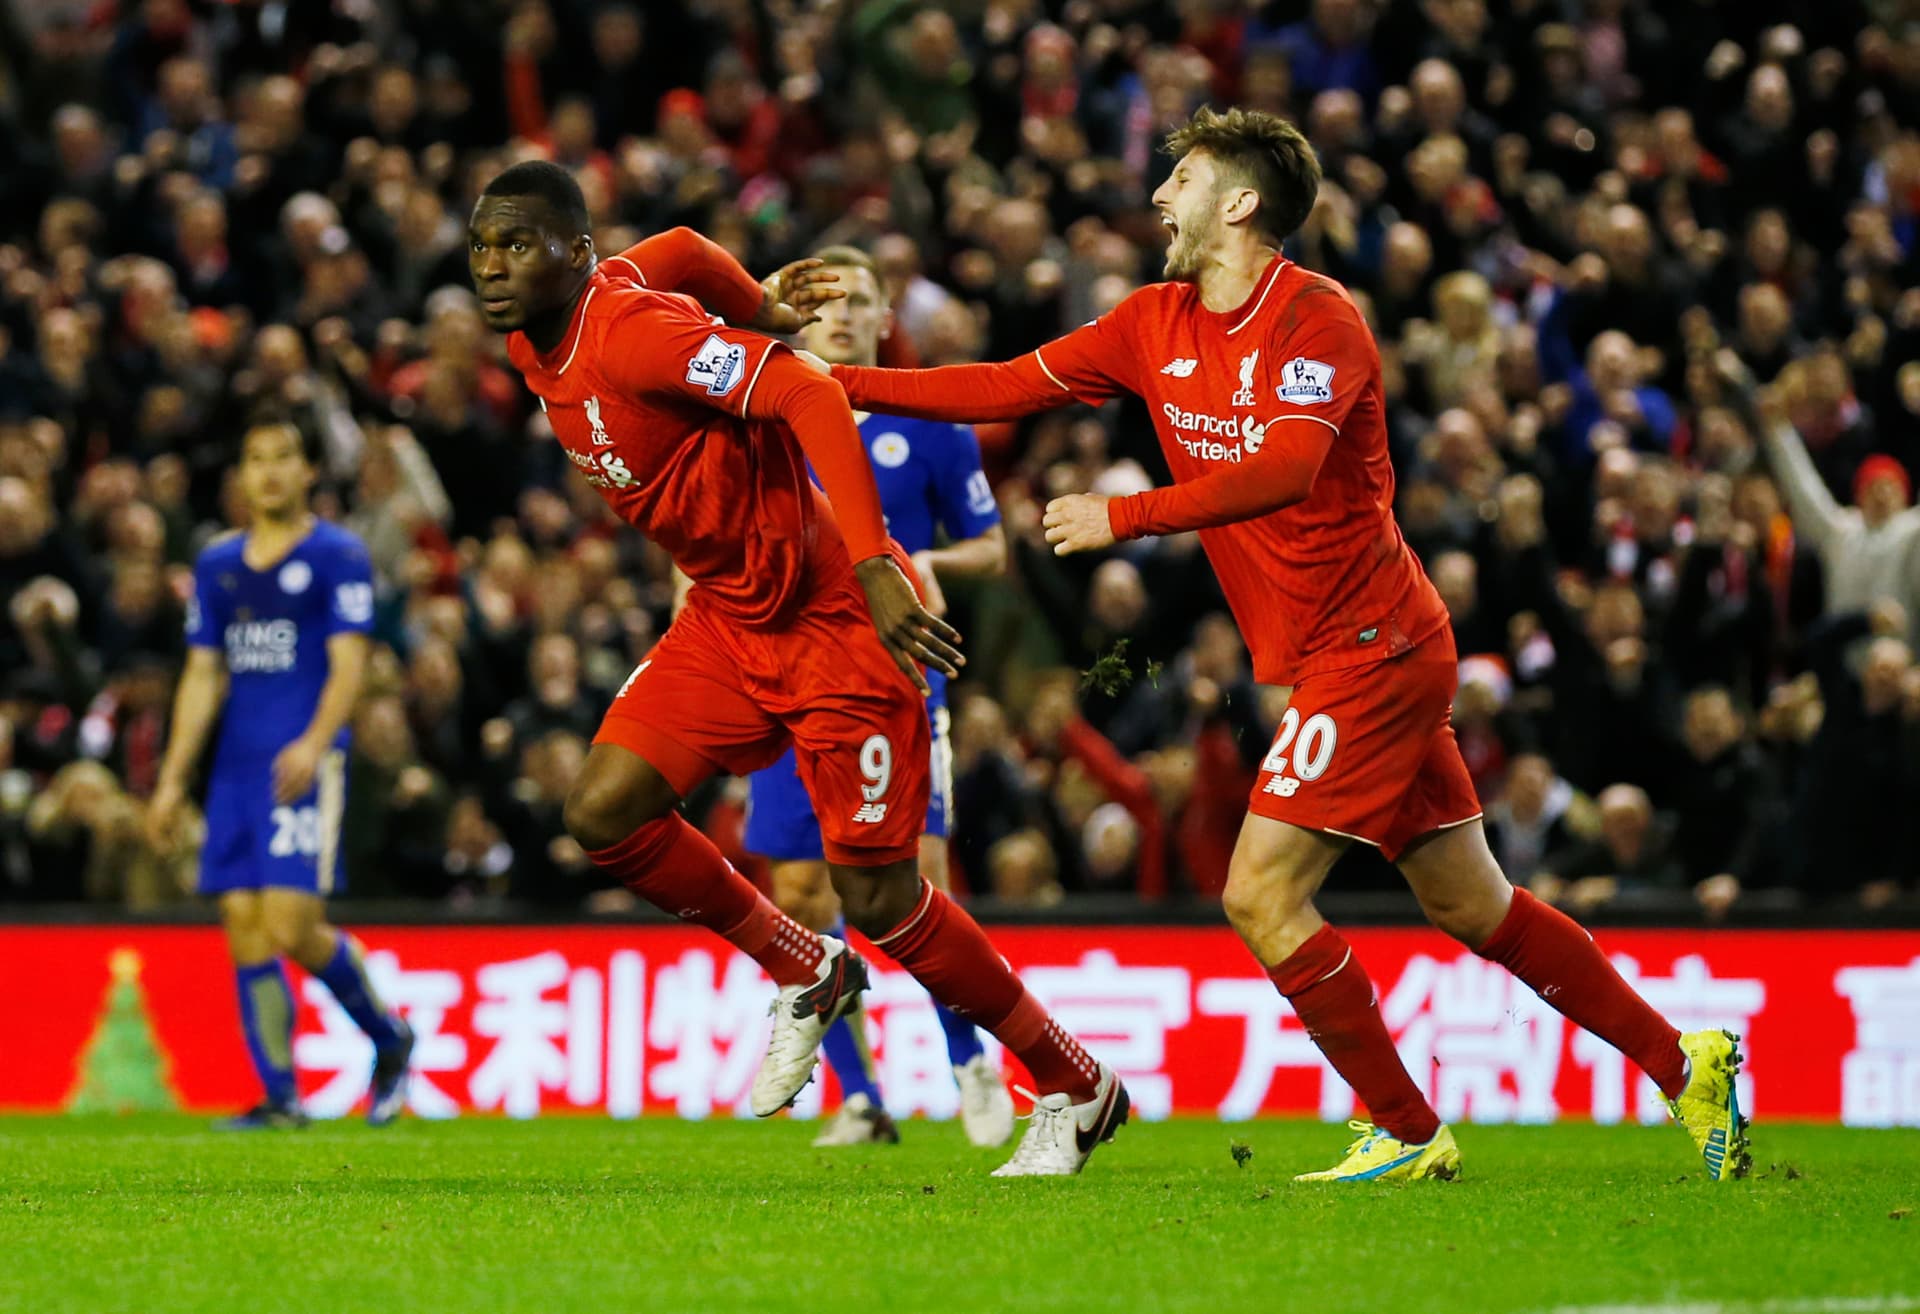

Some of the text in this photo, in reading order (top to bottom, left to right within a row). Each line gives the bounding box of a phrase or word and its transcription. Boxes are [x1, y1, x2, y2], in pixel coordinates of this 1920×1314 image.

[1163, 402, 1239, 437] Stanrd
[859, 734, 891, 801] 9
[1261, 706, 1337, 782] 20
[268, 805, 320, 857] 20
